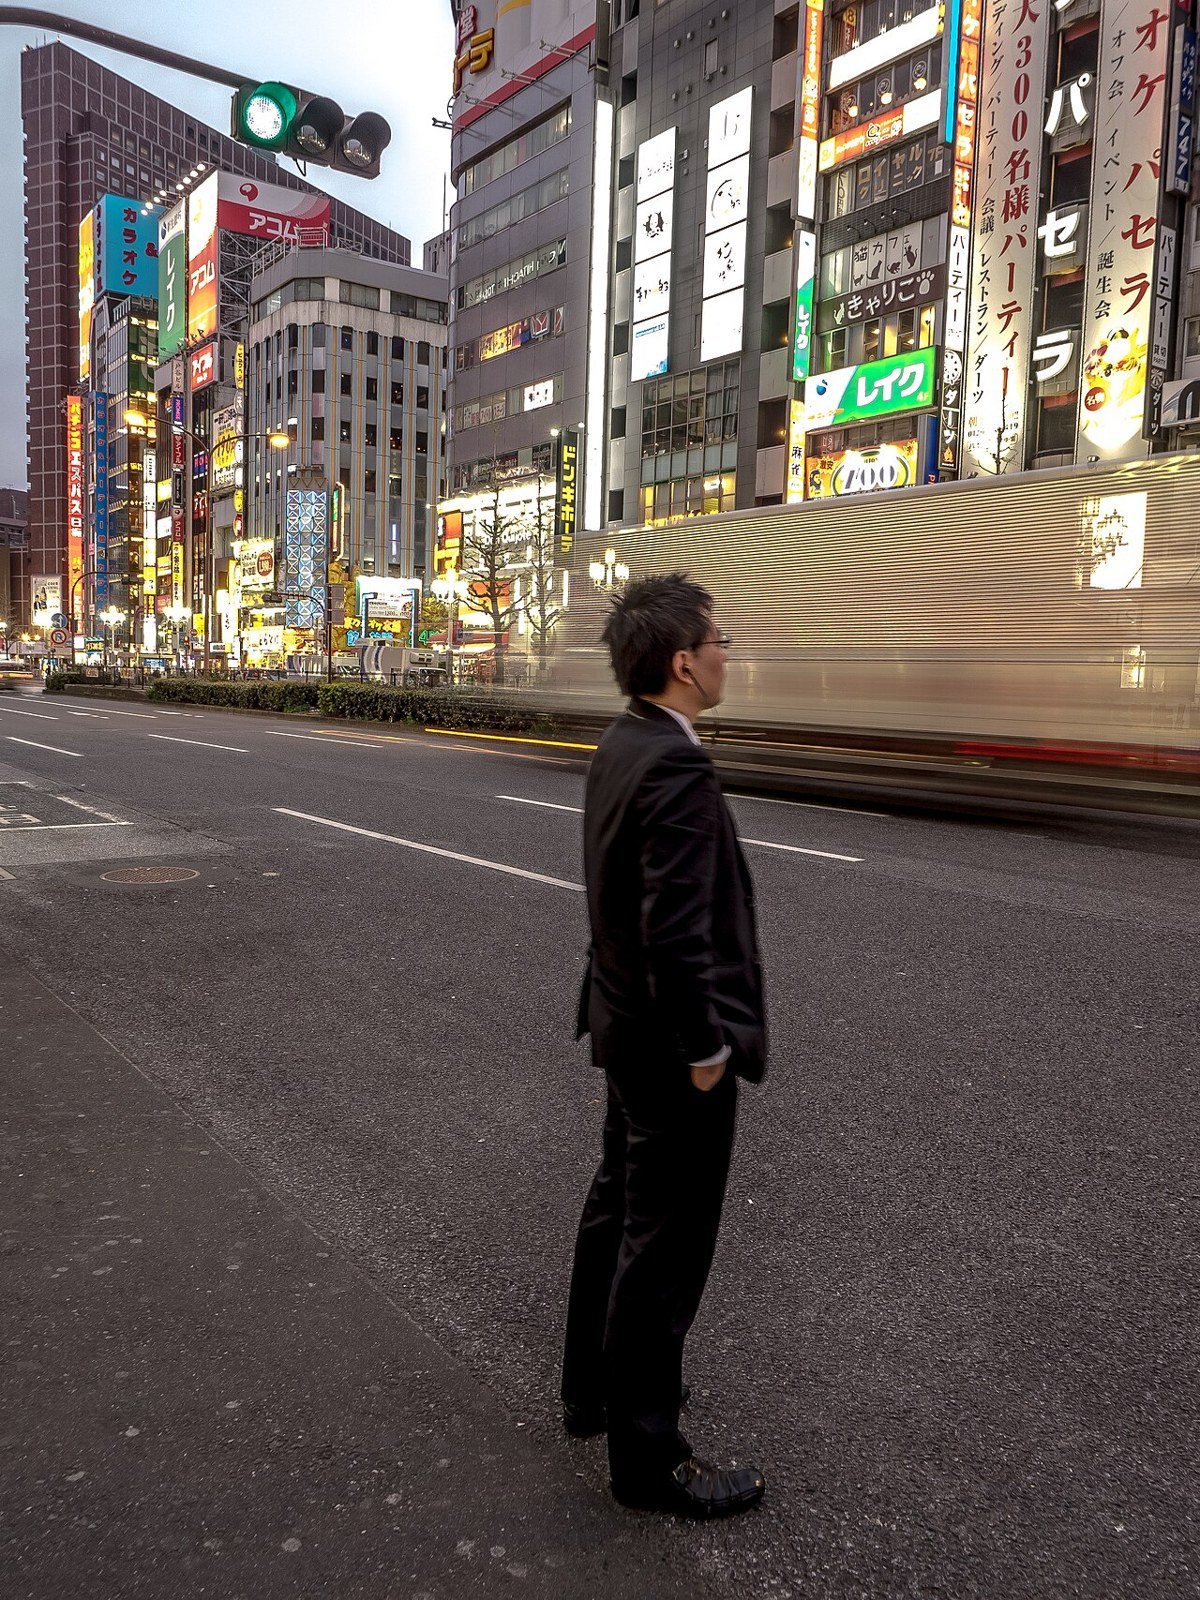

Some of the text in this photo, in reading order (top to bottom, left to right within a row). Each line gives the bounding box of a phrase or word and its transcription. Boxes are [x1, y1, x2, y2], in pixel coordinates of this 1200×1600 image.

[1176, 117, 1191, 176] 747
[1033, 0, 1092, 382] パセラ
[121, 207, 138, 285] カラオケ
[249, 212, 299, 240] アコム
[853, 234, 911, 262] 猫カフェ
[166, 249, 176, 332] レイク
[190, 260, 216, 296] アコム
[847, 277, 915, 320] きゃりこ
[1157, 234, 1174, 339] パーティー
[795, 304, 810, 350] レイク
[856, 362, 925, 407] レイク
[791, 445, 803, 476] 麻雀
